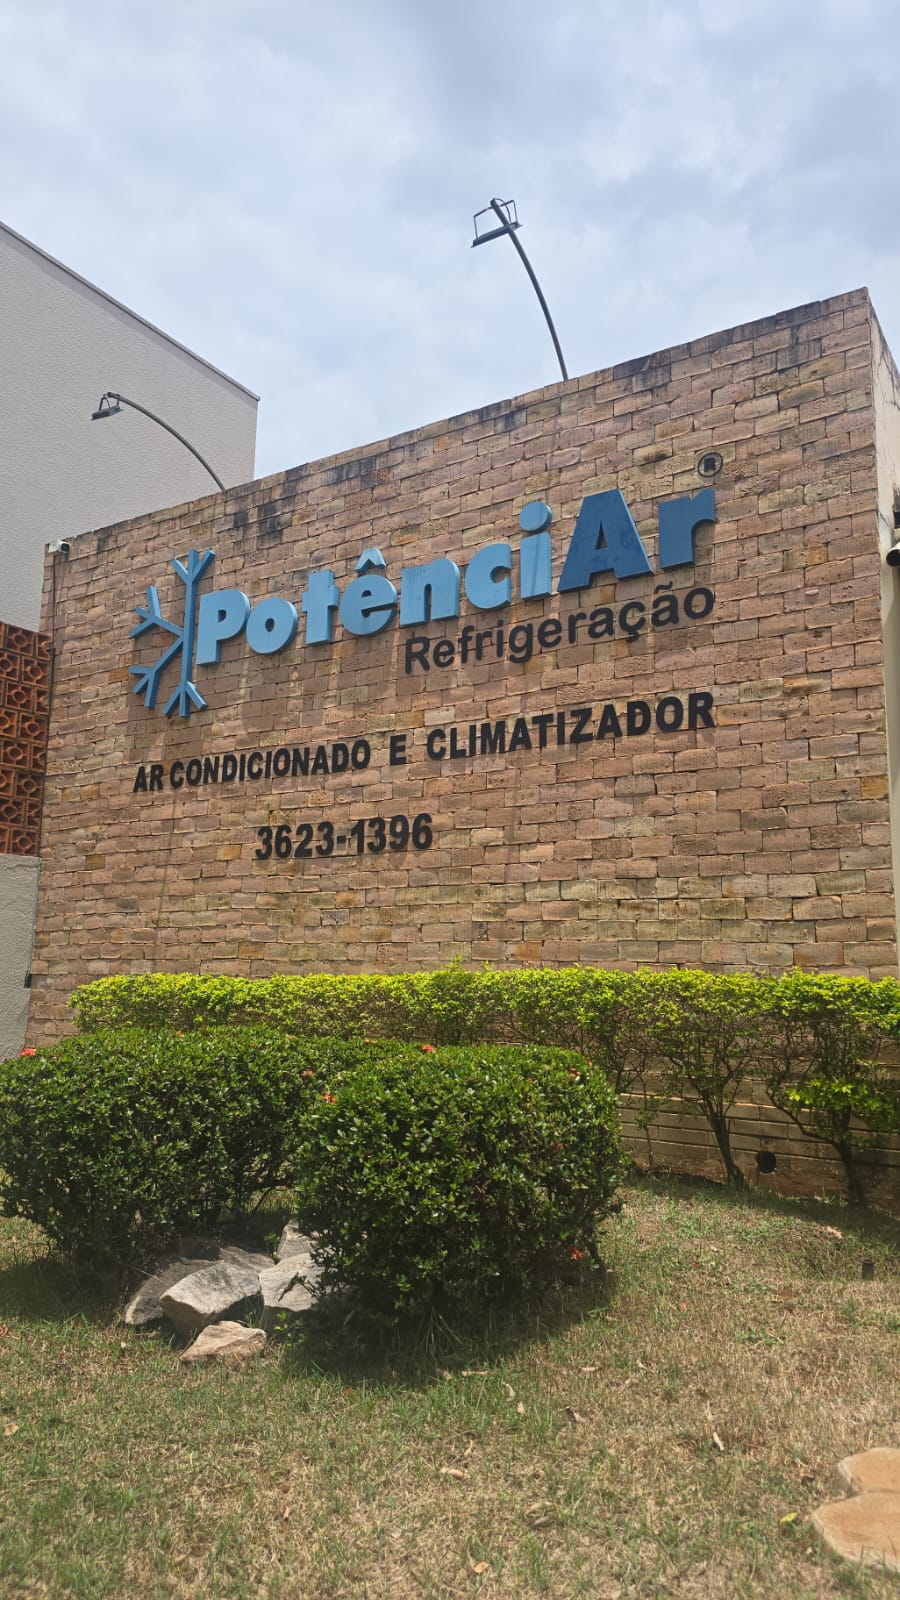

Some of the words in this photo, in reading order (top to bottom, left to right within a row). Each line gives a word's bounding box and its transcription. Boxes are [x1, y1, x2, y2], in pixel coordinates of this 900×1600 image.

[196, 487, 717, 665] PotênciAr
[404, 582, 715, 674] Refrigeração
[133, 763, 164, 793] AR
[169, 739, 371, 789] CONDICIONADO
[389, 733, 407, 766] E
[426, 691, 716, 760] CLIMATIZADOR
[255, 813, 433, 860] 3623-1396
